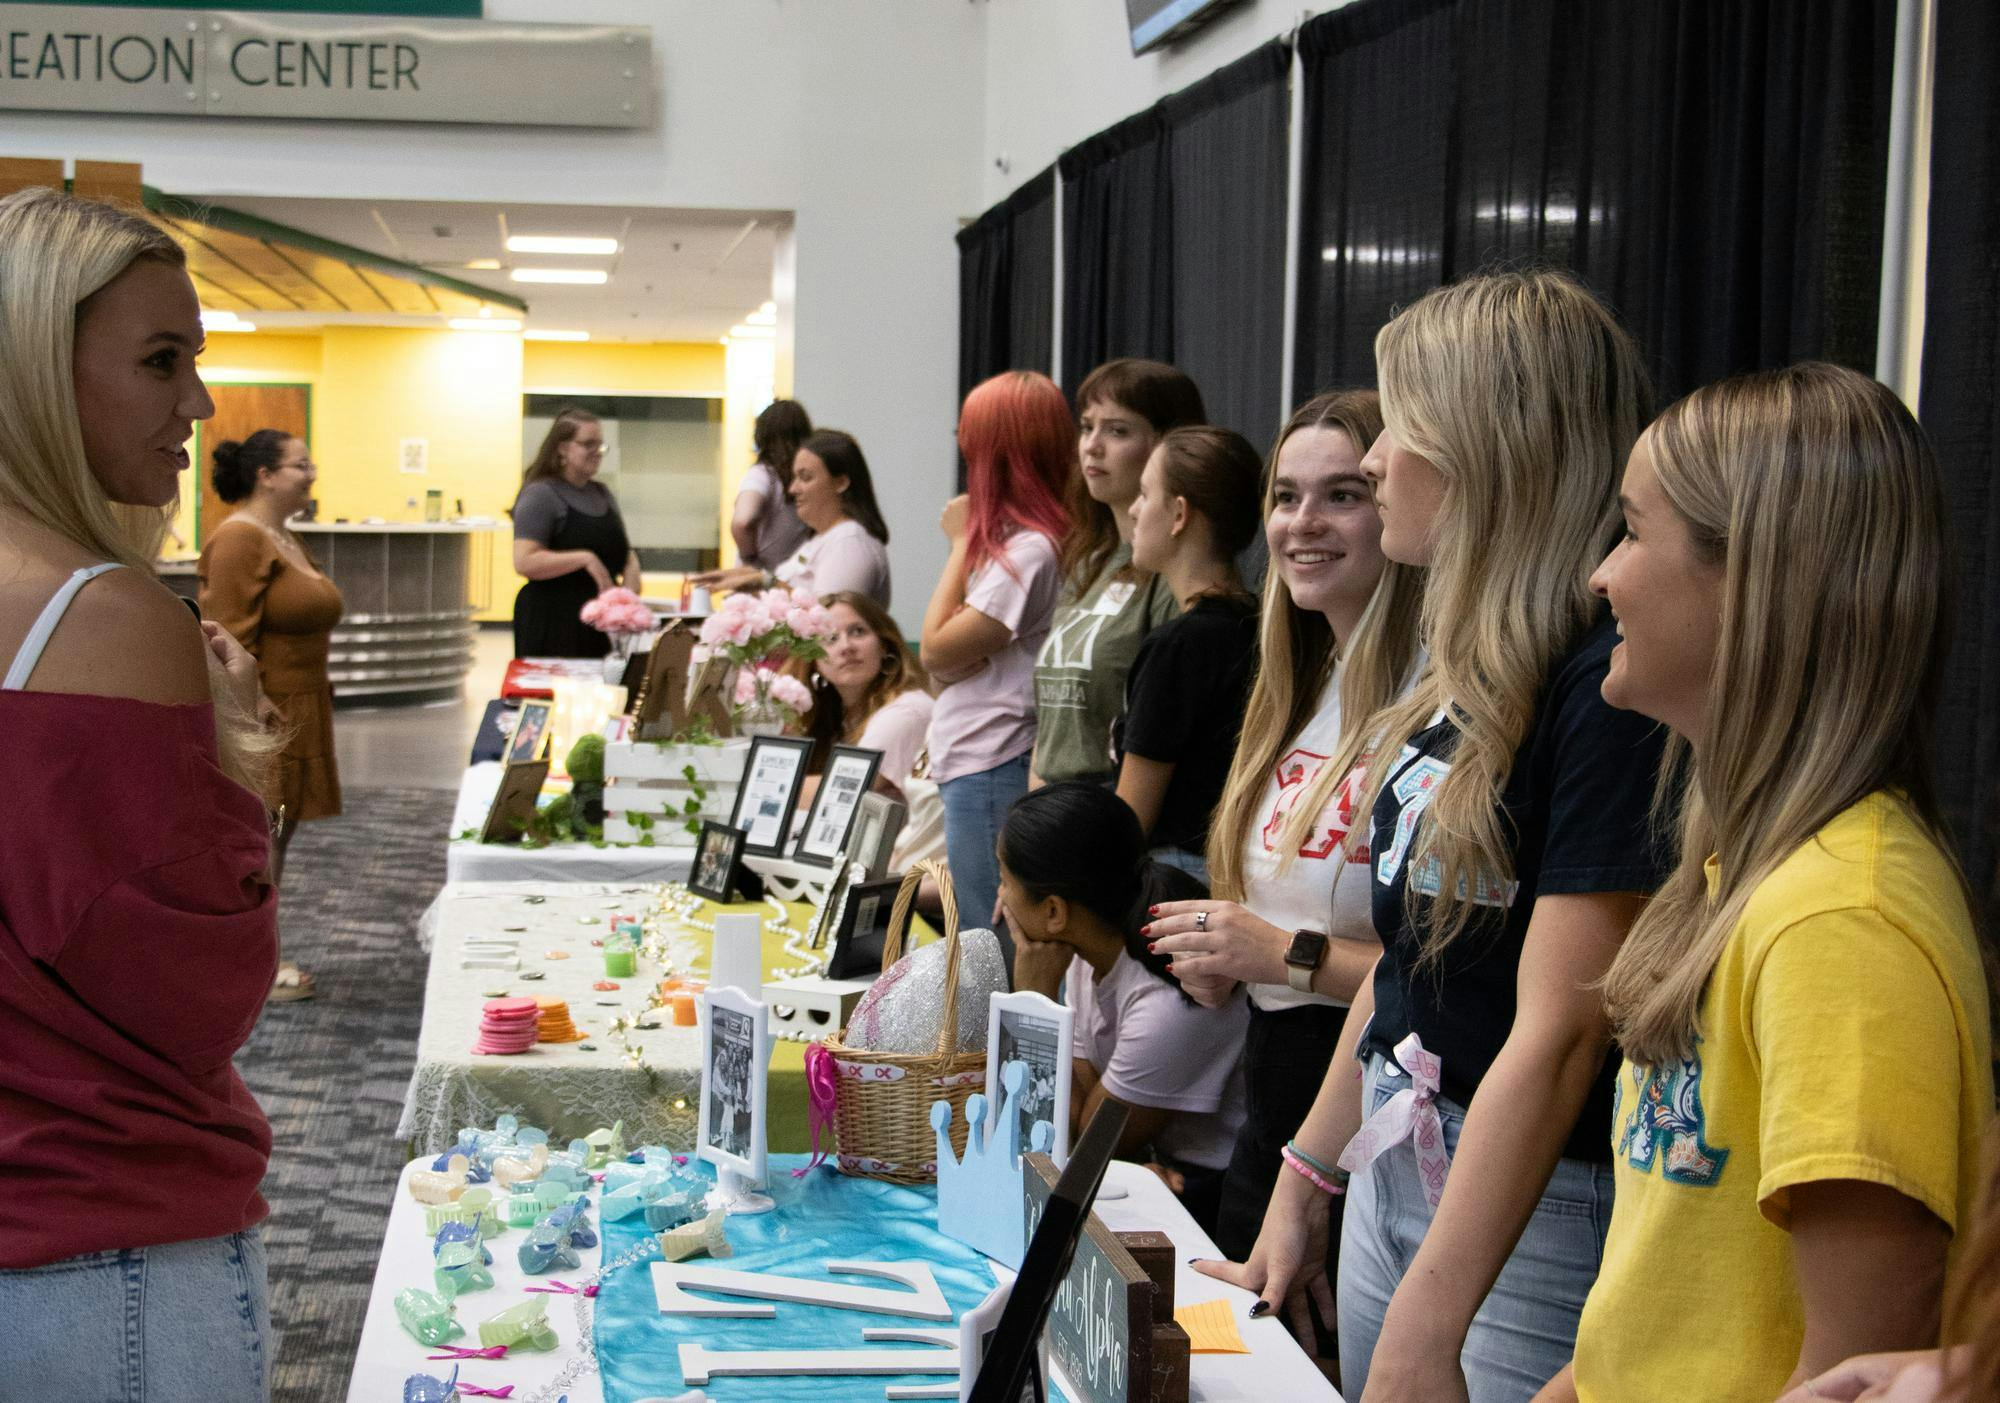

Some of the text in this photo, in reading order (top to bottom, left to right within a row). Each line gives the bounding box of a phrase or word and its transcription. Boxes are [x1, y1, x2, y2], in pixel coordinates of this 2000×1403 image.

[0, 32, 420, 91] EATION CENTER
[1075, 1255, 1125, 1397] Alpha
